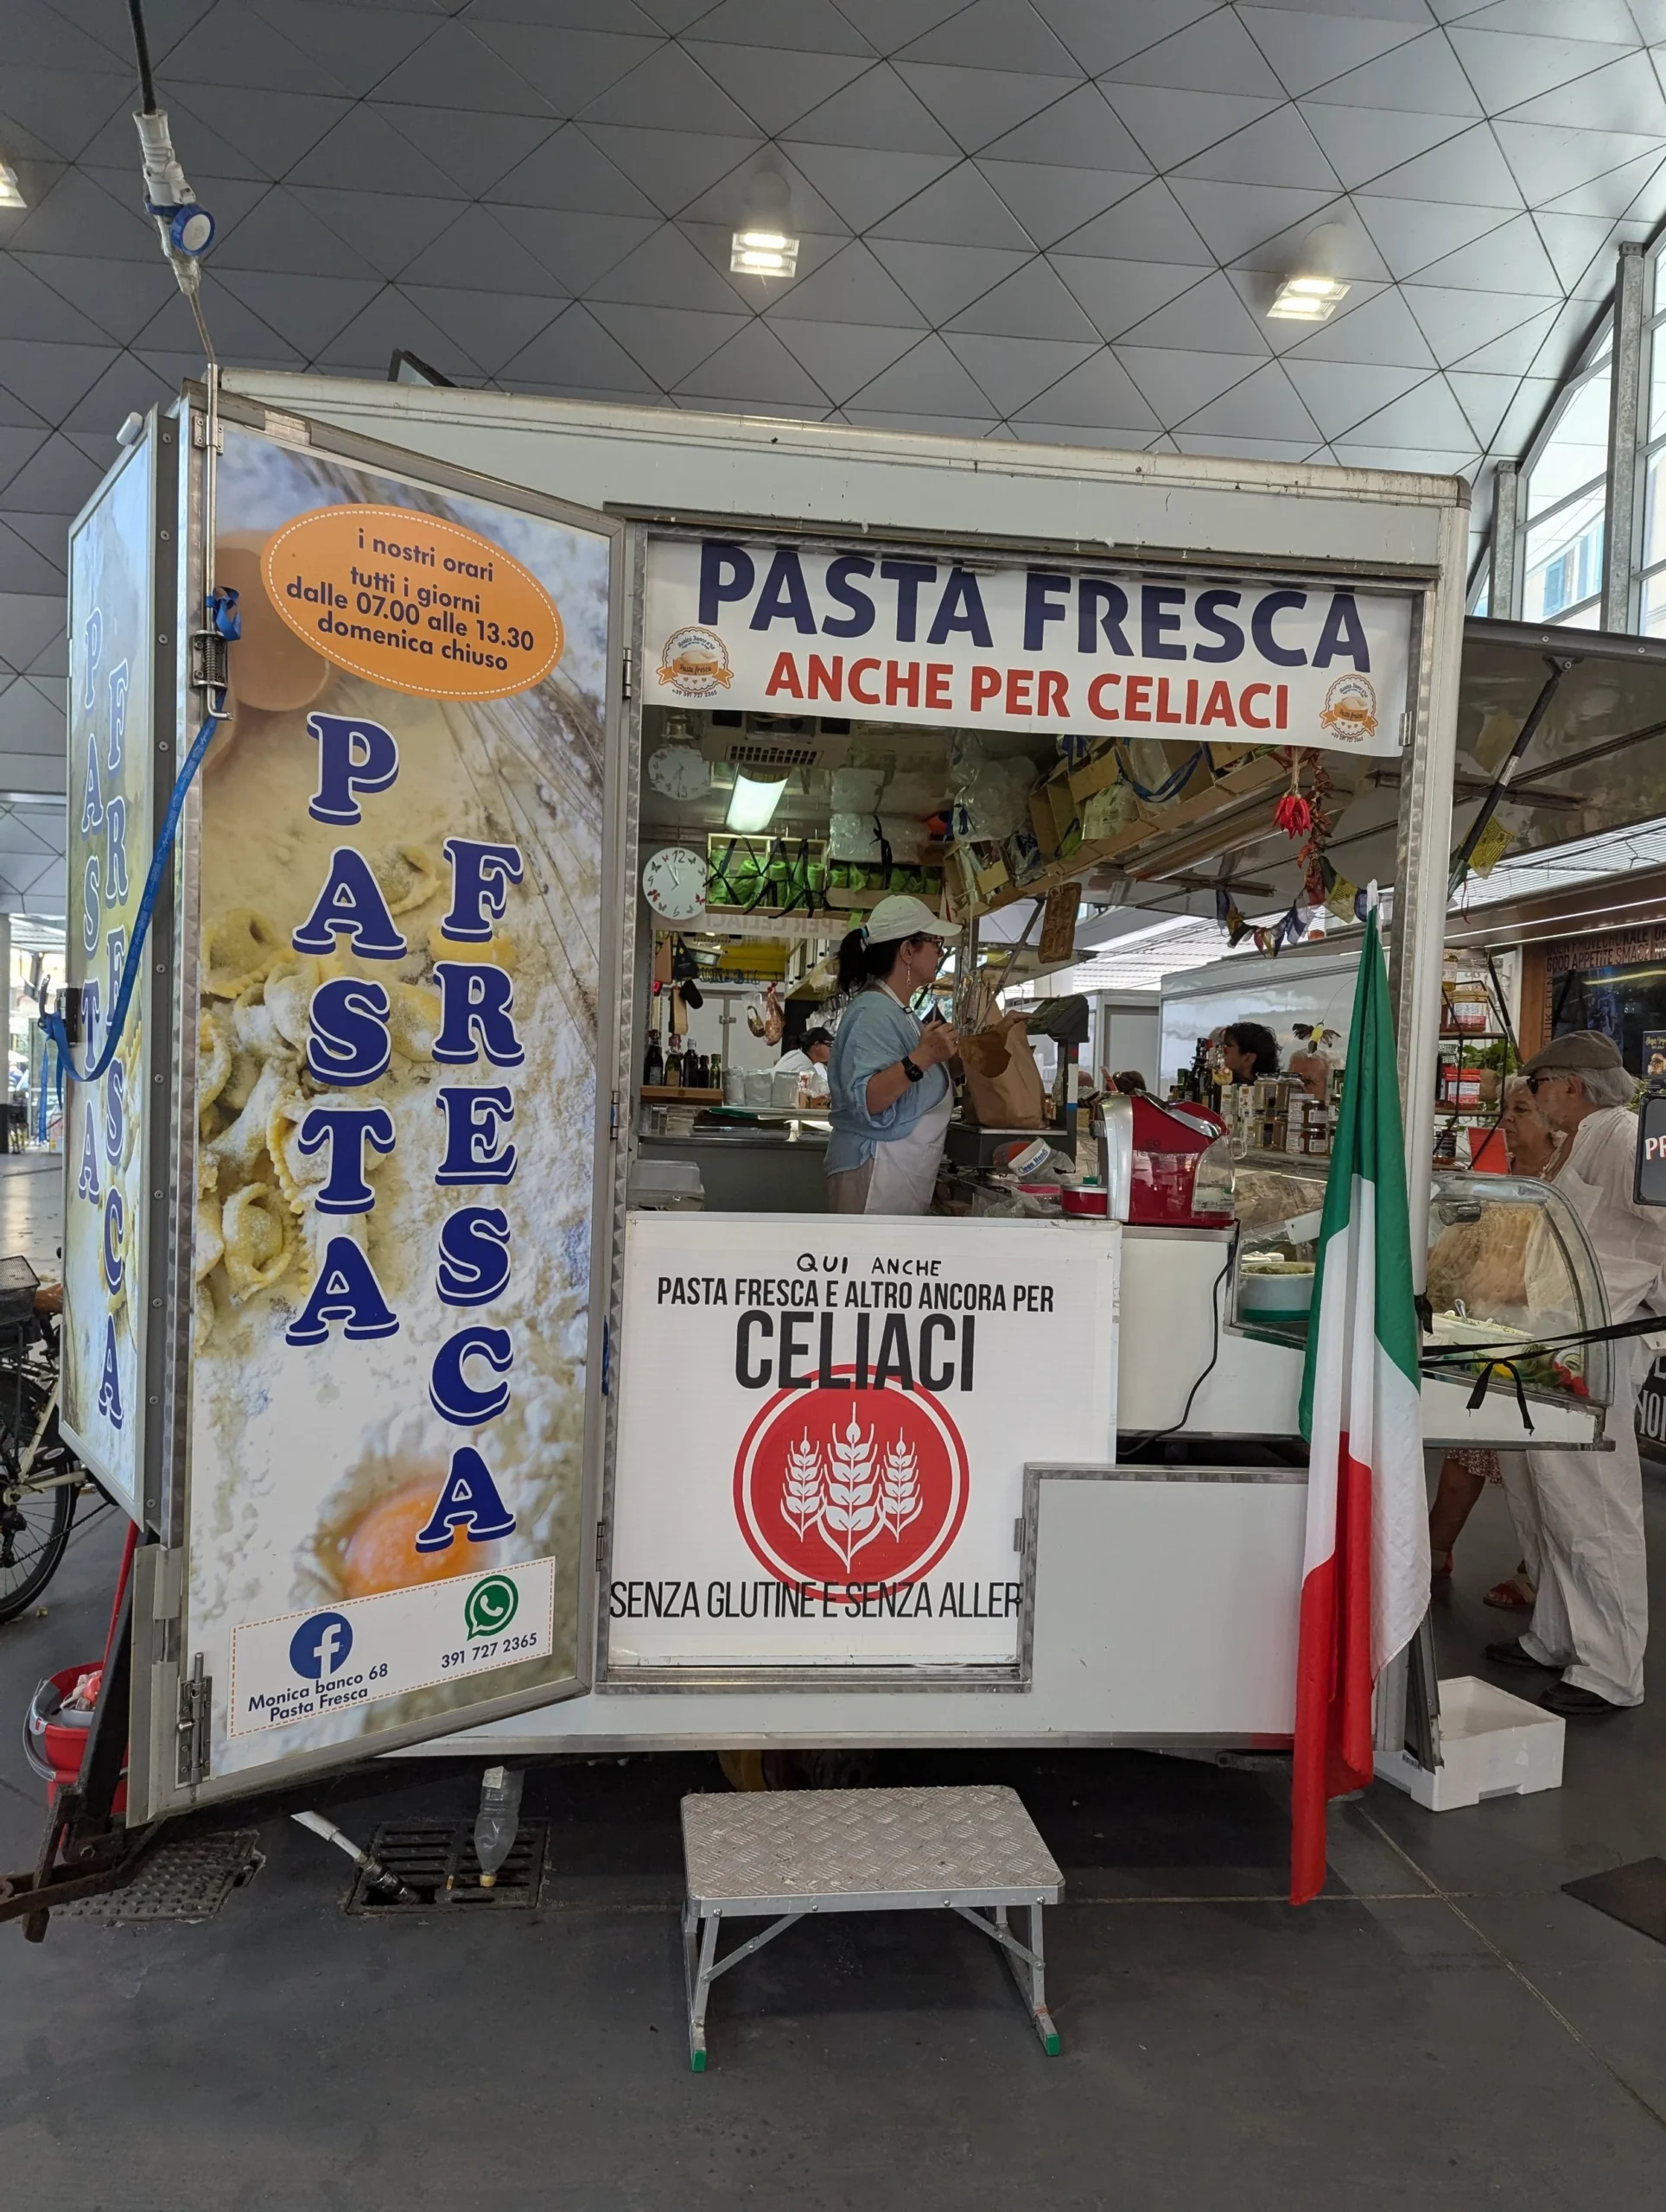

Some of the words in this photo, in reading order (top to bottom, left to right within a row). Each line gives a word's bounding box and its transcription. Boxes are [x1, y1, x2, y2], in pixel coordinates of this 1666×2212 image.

[358, 528, 365, 550] i
[372, 537, 436, 568] nostri
[442, 553, 494, 582] orari
[286, 576, 347, 609] dalle
[357, 592, 420, 626] 07.00
[428, 607, 467, 638] alle
[477, 620, 534, 652] 13.30
[351, 566, 396, 594] tutti
[404, 577, 410, 597] i
[417, 582, 480, 614] giorni
[698, 543, 993, 648] PASTA
[1022, 571, 1371, 673] FRESCA
[317, 611, 434, 656] domenica
[442, 638, 508, 671] chiuso
[765, 652, 953, 710] ANCHE
[970, 666, 1071, 718] PER
[1087, 676, 1288, 730] CELIACI
[671, 850, 685, 863] 12
[78, 606, 104, 1205] PASTA
[285, 711, 407, 1346] PASTA
[1018, 1160, 1035, 1176] Clean
[1034, 1148, 1049, 1166] Hands
[415, 836, 525, 1554] FRESCA
[797, 1253, 849, 1275] QUI
[872, 1256, 942, 1277] ANCHE
[657, 1277, 728, 1306] PASTA
[734, 1280, 819, 1307] FRESCA
[825, 1281, 838, 1308] E
[844, 1281, 912, 1310] ALTRO
[919, 1283, 1006, 1312] ANCORA
[1013, 1285, 1054, 1313] PER
[735, 1309, 976, 1392] CELIACI
[610, 1581, 700, 1618] SENZA
[707, 1582, 816, 1618] GLUTINE
[824, 1583, 838, 1618] E
[845, 1583, 932, 1618] SENZA
[441, 1650, 465, 1669] 391
[472, 1642, 499, 1662] 727
[503, 1632, 538, 1654] 2365
[248, 1685, 309, 1713] Monica
[315, 1673, 364, 1694] banco
[369, 1663, 389, 1681] 68
[270, 1699, 315, 1724] Pasta
[319, 1686, 369, 1711] Fresca
